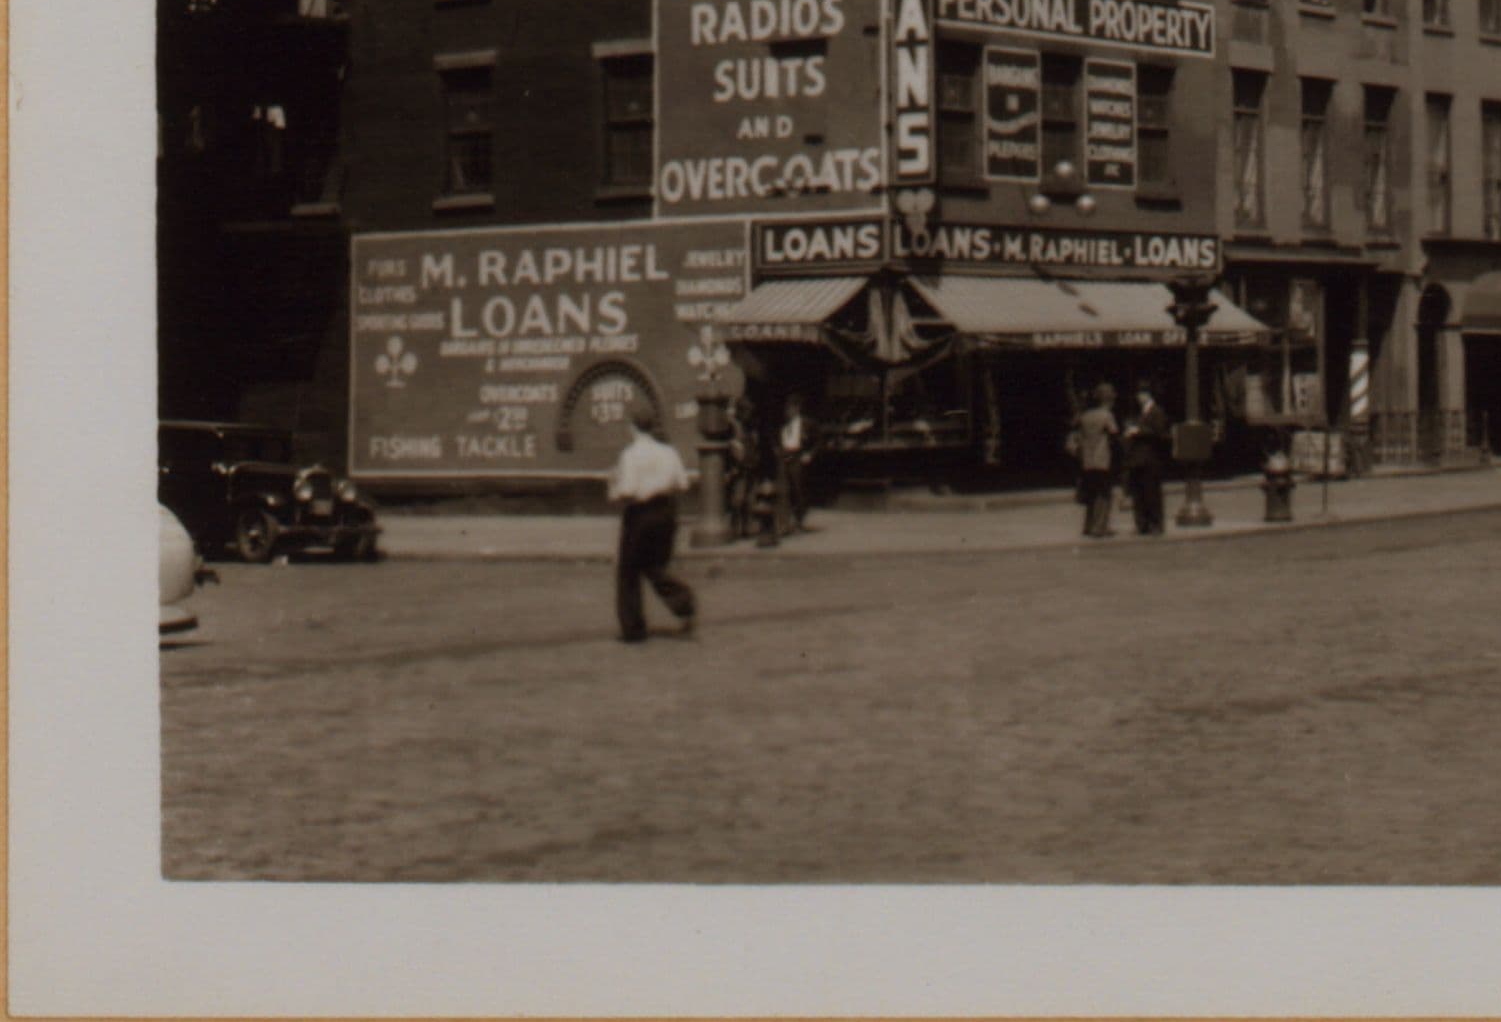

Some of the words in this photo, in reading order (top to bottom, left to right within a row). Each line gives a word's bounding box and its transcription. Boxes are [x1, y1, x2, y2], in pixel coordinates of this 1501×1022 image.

[713, 56, 825, 102] SUITS
[737, 116, 792, 139] AND
[661, 148, 880, 203] OVERCOATS
[766, 223, 880, 261] LOANS
[895, 224, 990, 260] LOANS
[1135, 237, 1215, 267] LOANS
[479, 244, 669, 284] RAPHIEL
[451, 292, 627, 337] LOANS
[369, 435, 442, 461] FISHING
[456, 433, 536, 459] TACKLE
